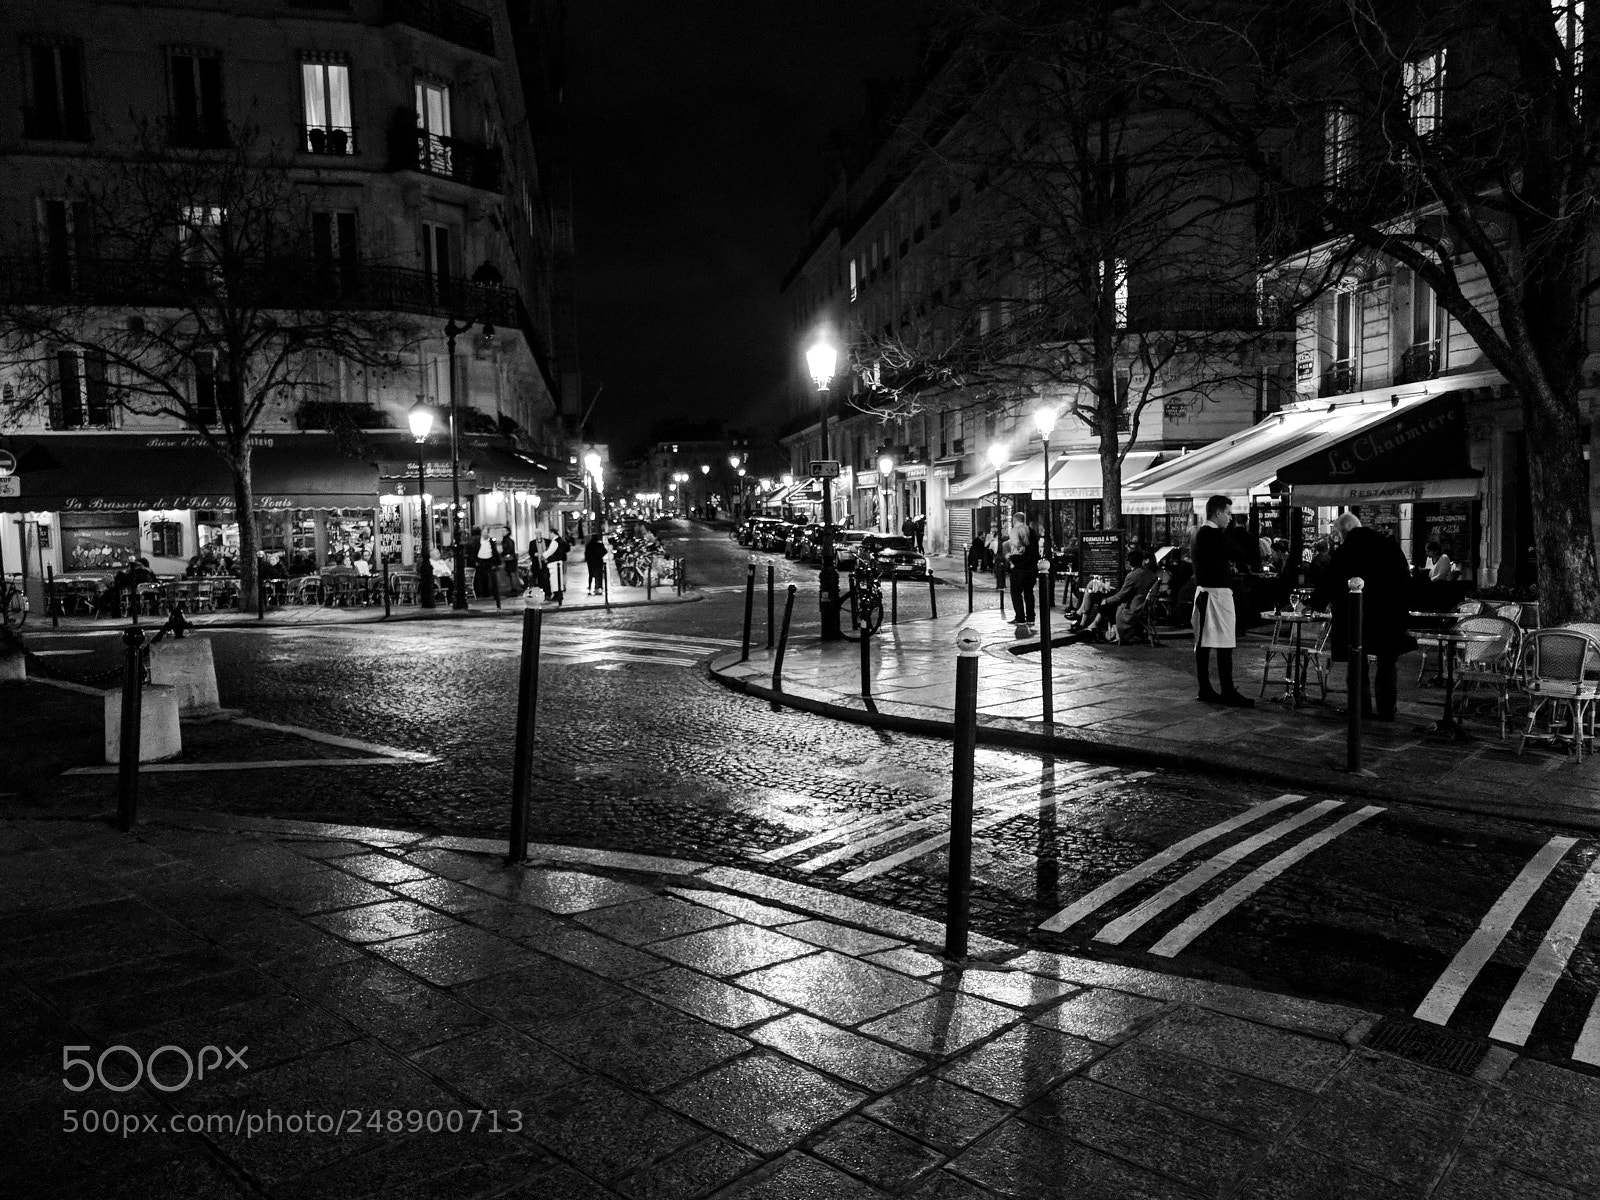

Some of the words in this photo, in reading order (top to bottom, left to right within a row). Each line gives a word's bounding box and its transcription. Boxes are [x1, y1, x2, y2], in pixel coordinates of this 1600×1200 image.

[1328, 448, 1356, 477] La
[1352, 408, 1457, 461] Chaumière
[1350, 487, 1426, 498] RESTAURANT
[64, 497, 82, 509] La
[88, 498, 148, 509] Brasserie
[153, 497, 168, 508] de
